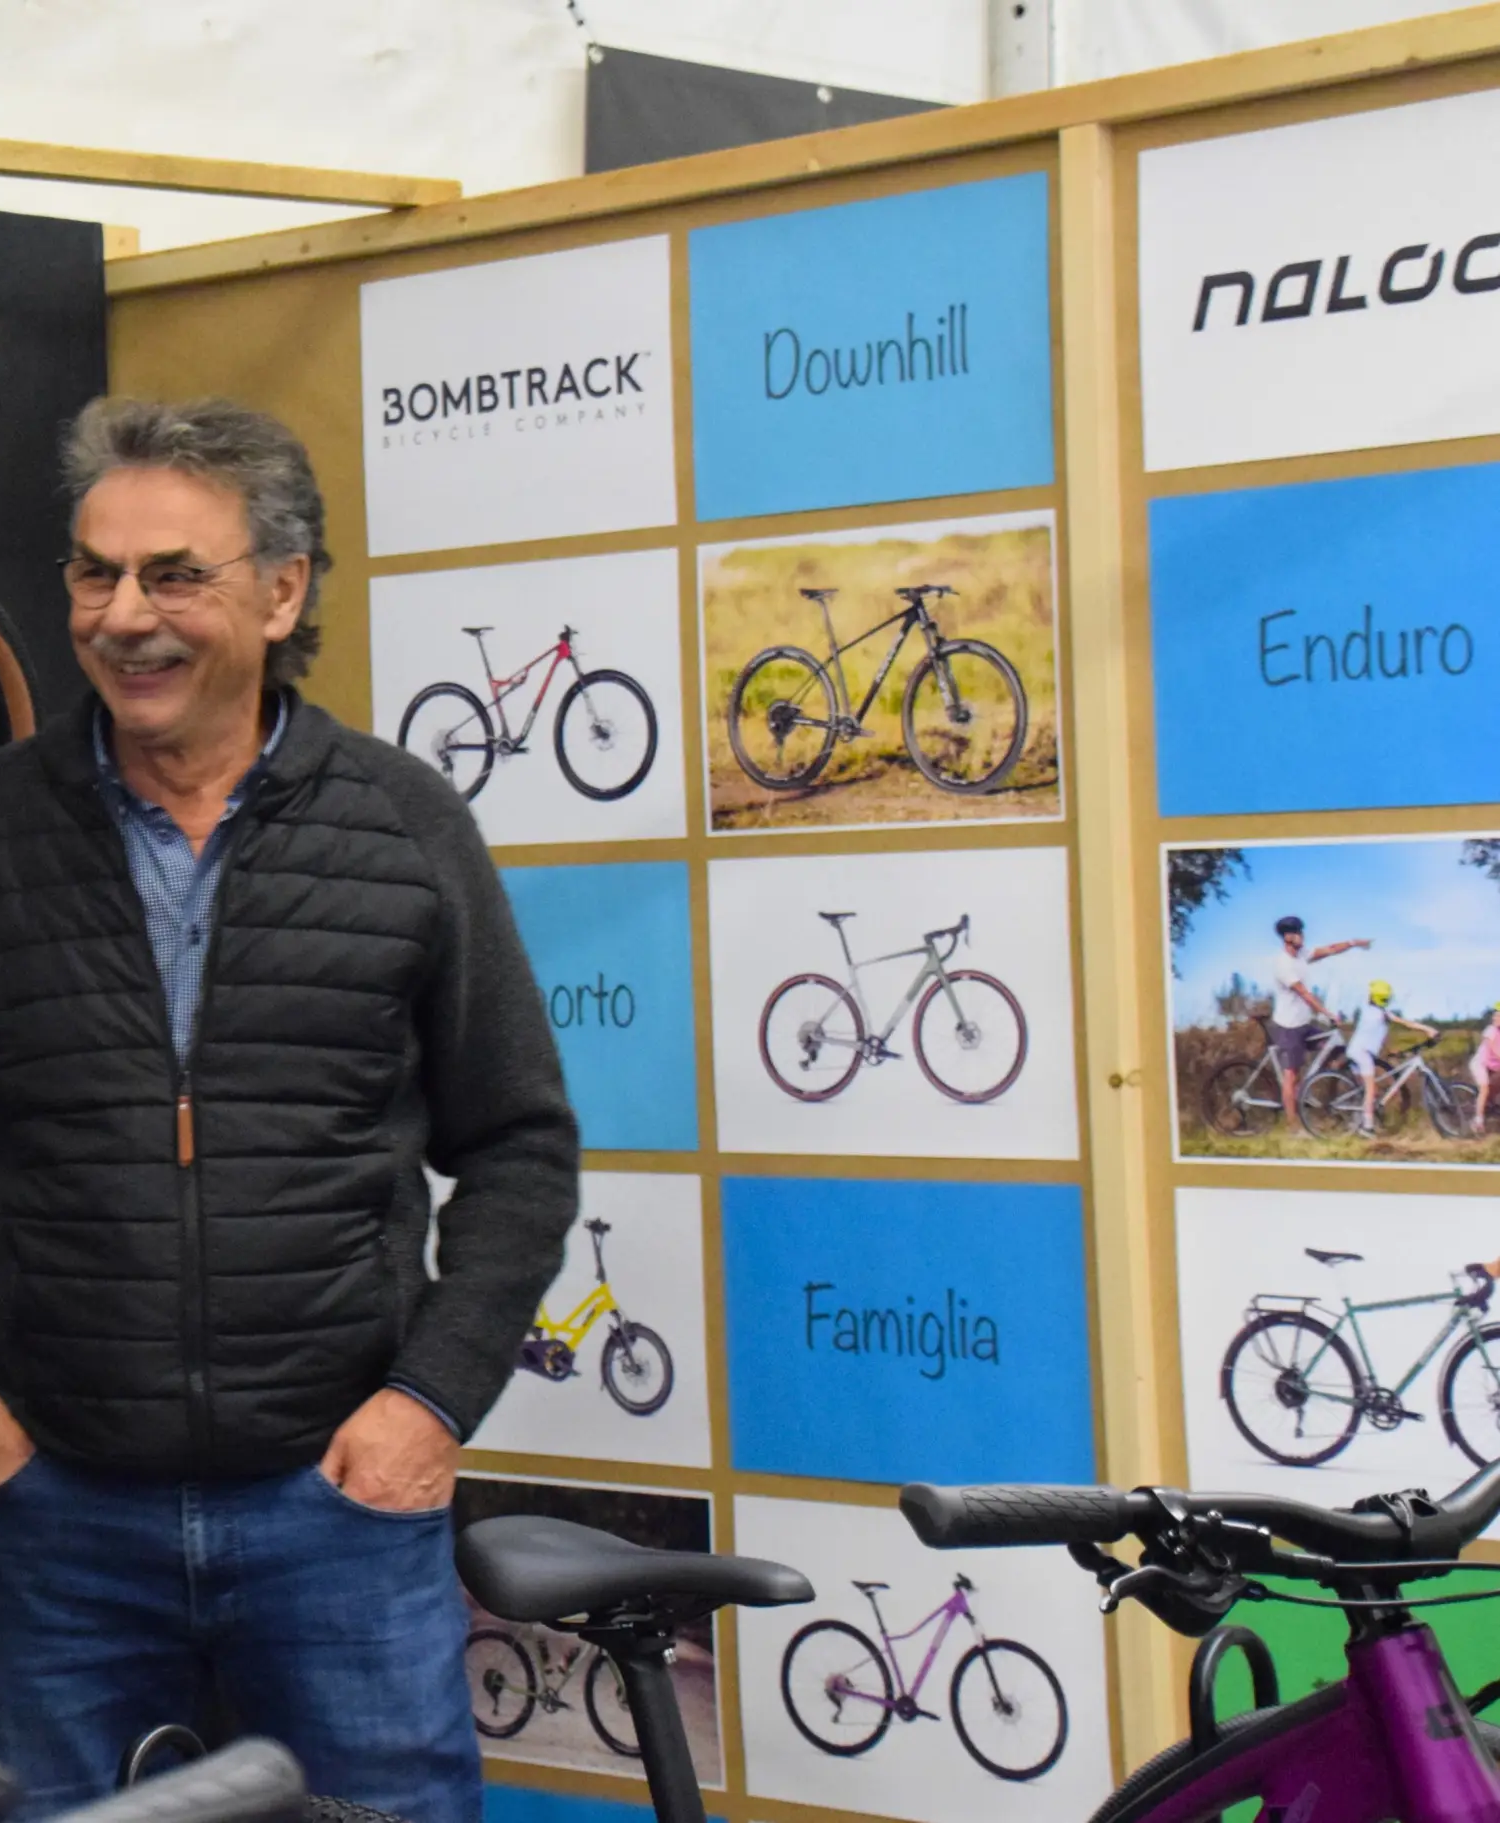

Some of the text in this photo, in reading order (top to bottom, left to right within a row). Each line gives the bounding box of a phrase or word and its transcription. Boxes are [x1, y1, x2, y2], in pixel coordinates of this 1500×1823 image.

[382, 352, 643, 426] BOMBTRACK
[764, 303, 970, 402] Downhill
[382, 403, 646, 450] BICYCLE COMPANY
[1258, 603, 1474, 687] Enduro
[803, 1281, 1001, 1382] Famiglia
